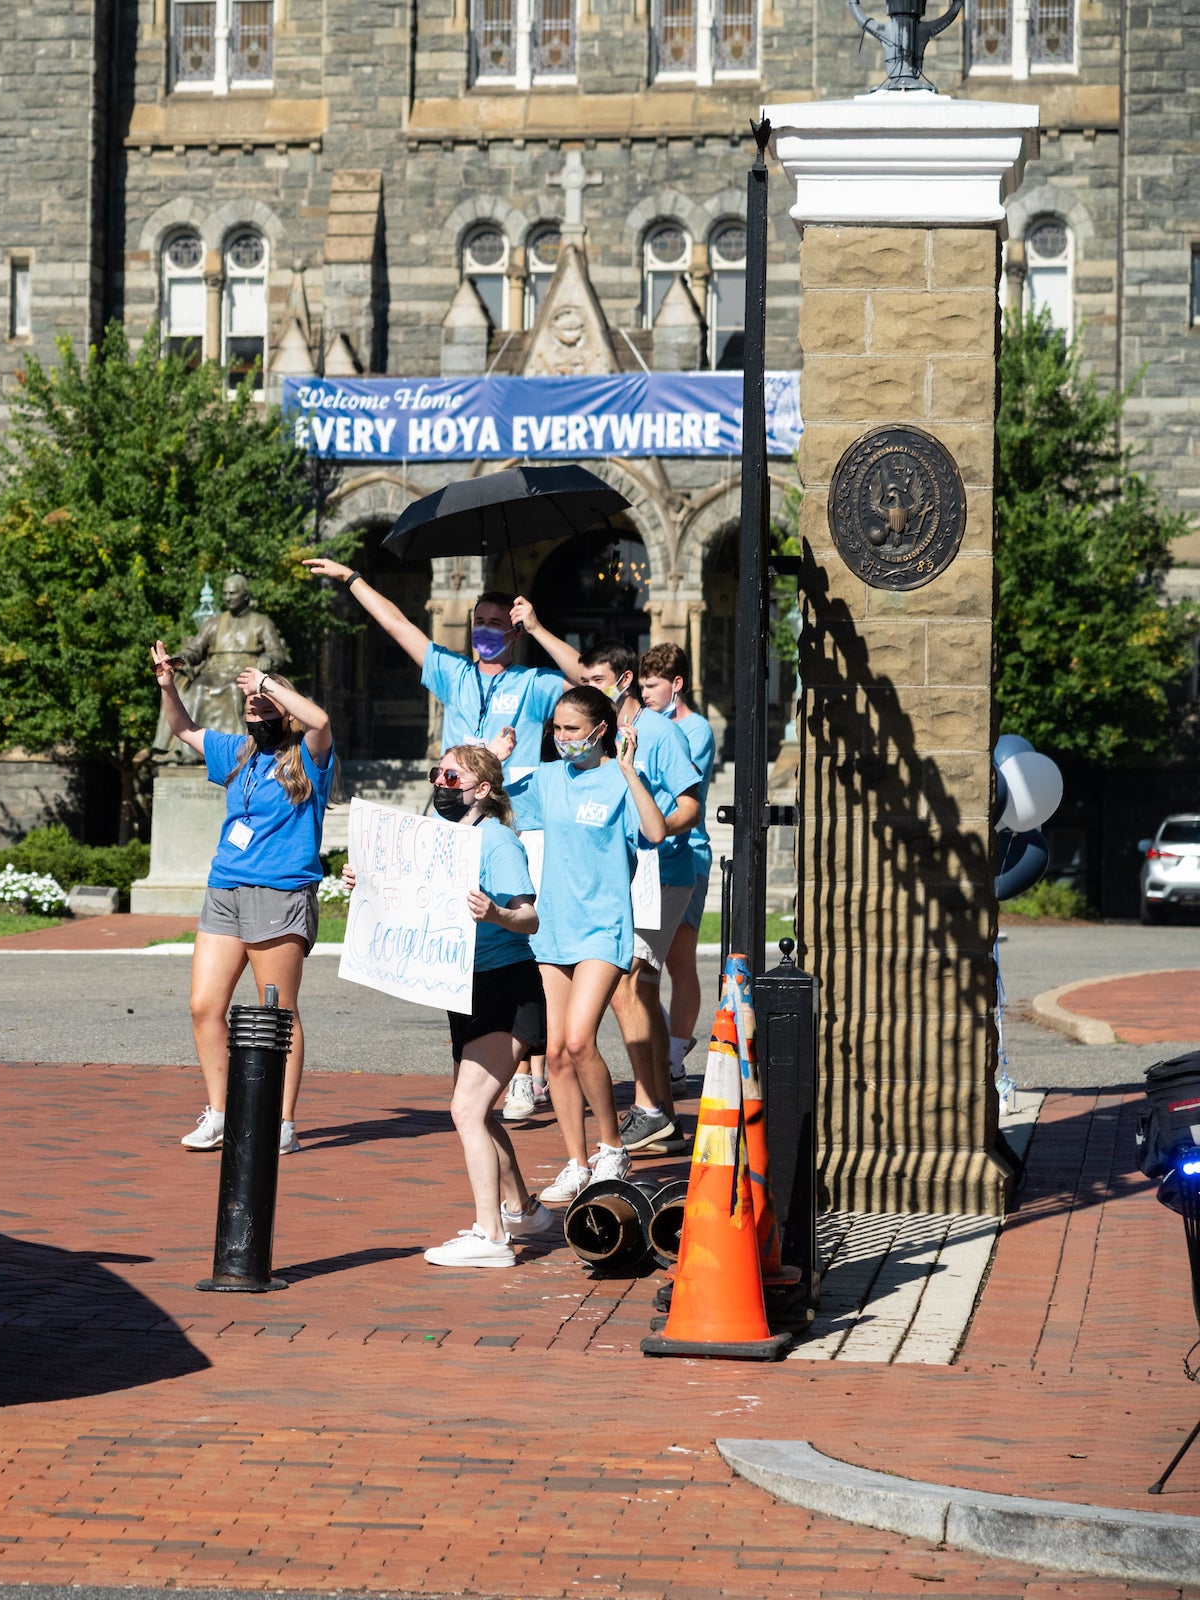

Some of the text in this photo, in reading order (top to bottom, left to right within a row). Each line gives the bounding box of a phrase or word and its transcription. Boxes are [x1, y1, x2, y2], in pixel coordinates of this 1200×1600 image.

[298, 384, 463, 410] Welcome Home
[408, 415, 500, 453] HOYA
[512, 412, 721, 451] EVERYWHERE
[576, 799, 608, 822] NSO
[352, 807, 471, 890] WELCOME
[349, 899, 472, 979] Georgetown
